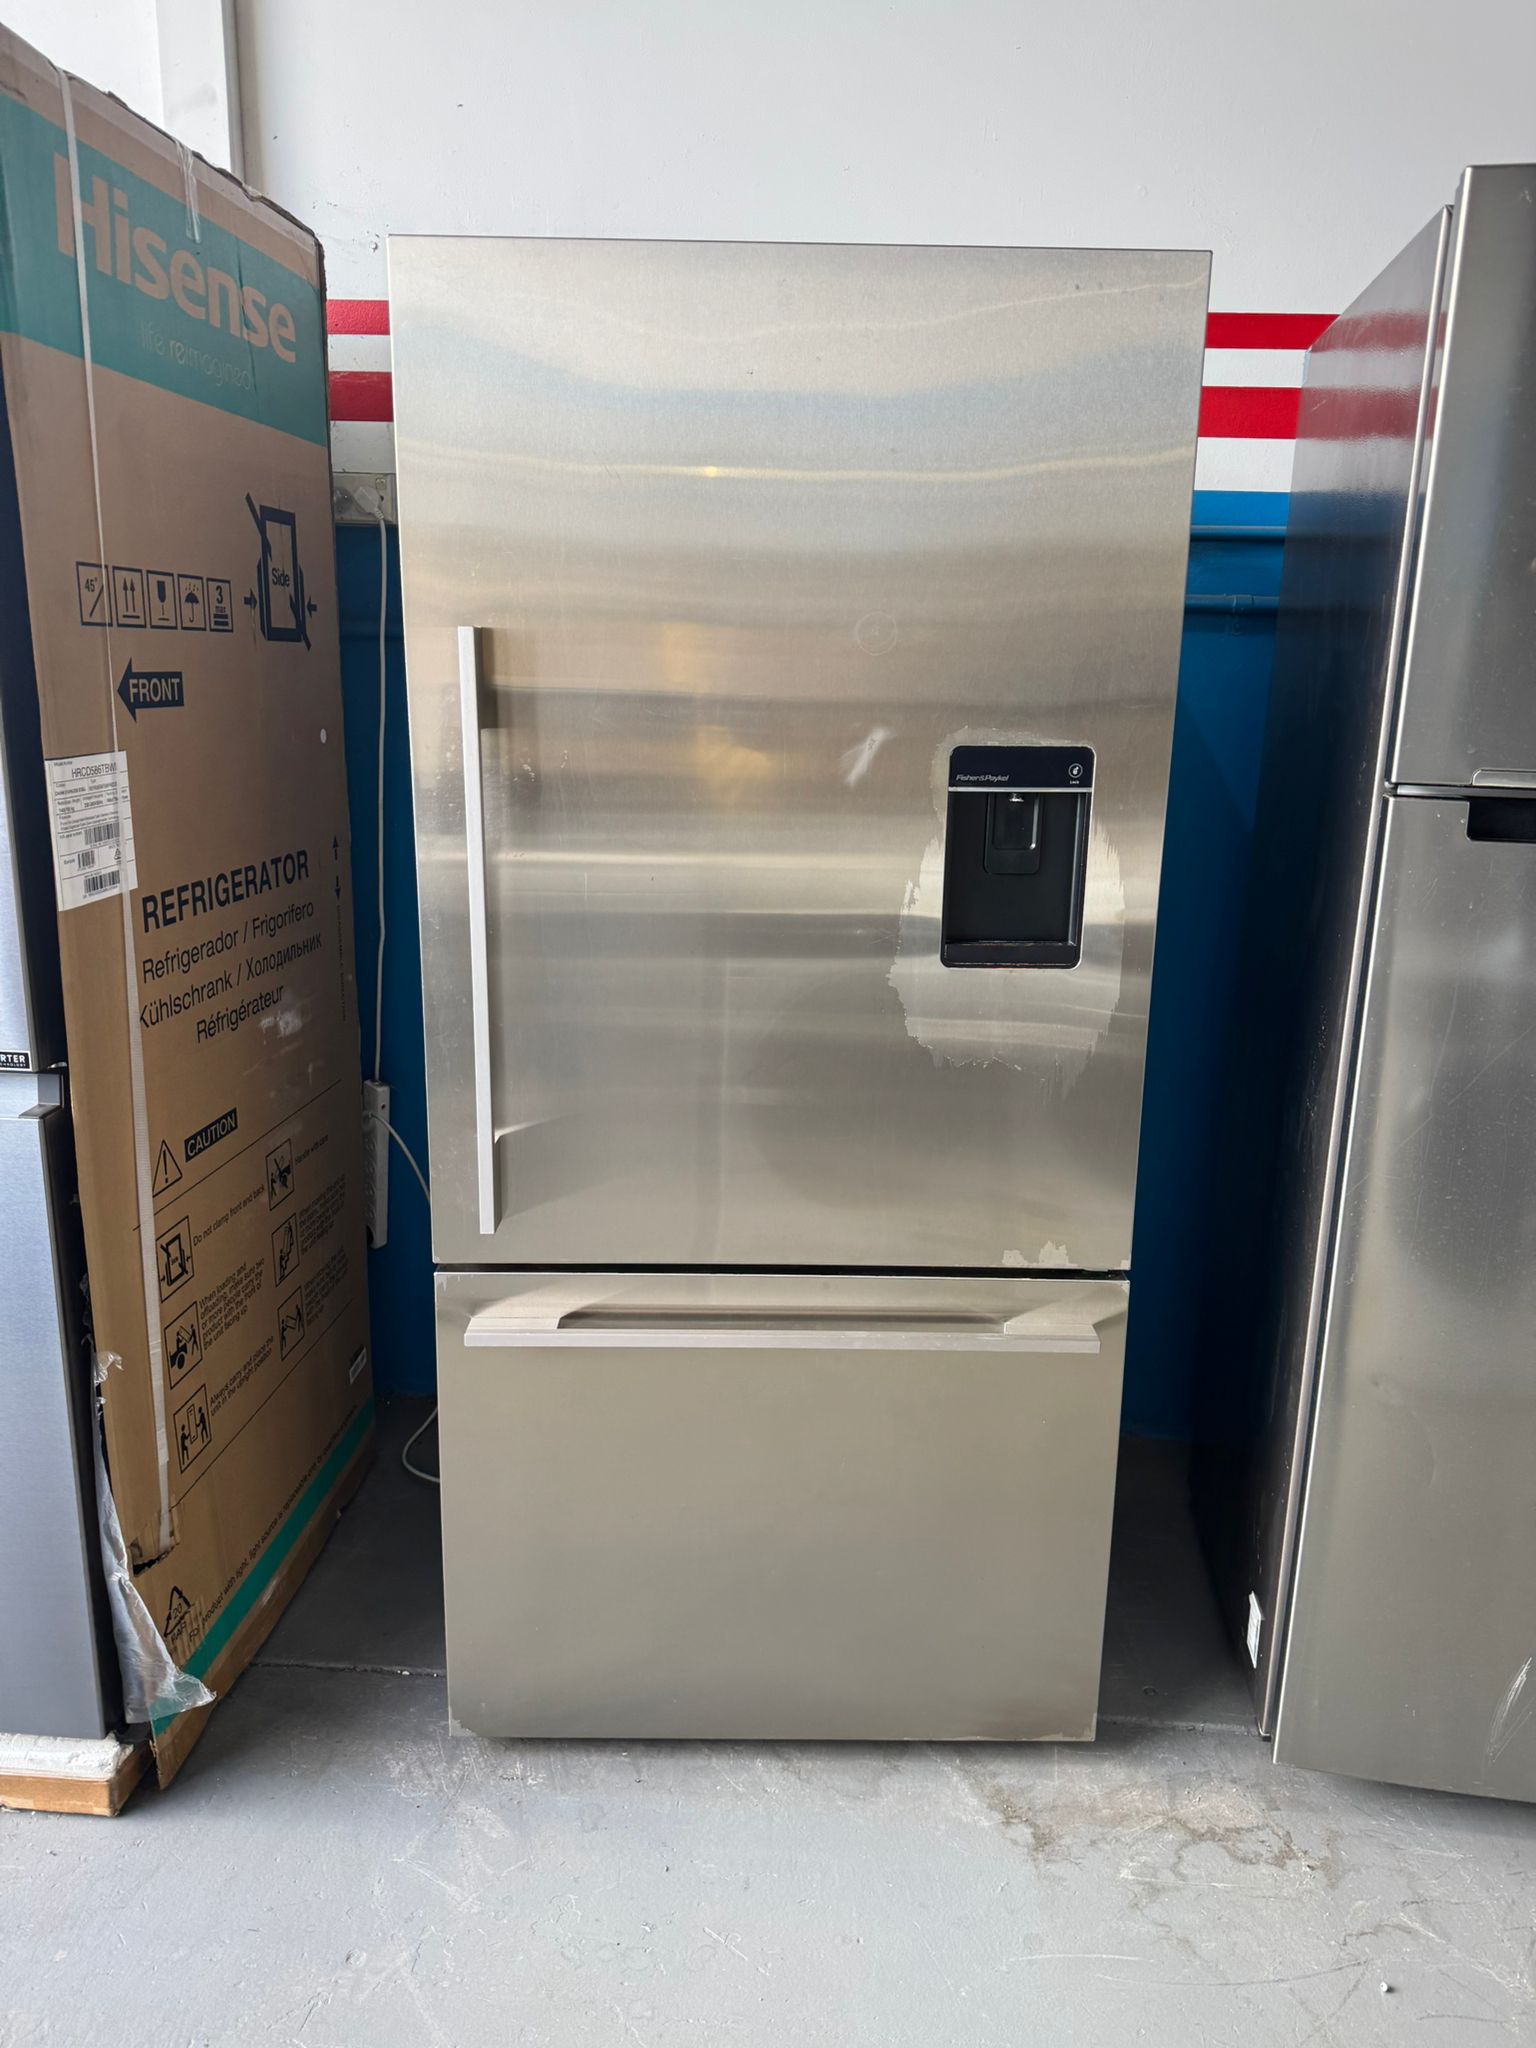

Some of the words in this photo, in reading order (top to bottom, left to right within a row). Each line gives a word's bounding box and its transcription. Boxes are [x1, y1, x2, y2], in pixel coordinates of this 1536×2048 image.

[53, 152, 296, 364] Hisense
[139, 320, 163, 356] life
[168, 339, 252, 390] reimagined
[215, 584, 224, 604] 3
[271, 567, 291, 588] Side
[128, 677, 181, 703] FRONT
[956, 774, 1010, 783] Fisher&Paykel
[142, 849, 310, 933] REFRIGERATOR
[142, 928, 239, 984] Refrigerador
[252, 900, 314, 940] Frigorifero
[246, 932, 323, 981] Холодильник
[196, 984, 285, 1043] Réfrigérateur
[186, 1112, 237, 1158] CAUTION
[192, 1235, 203, 1247] Do
[203, 1225, 213, 1239] not
[213, 1213, 229, 1231] clamp
[230, 1201, 242, 1218] front
[242, 1192, 253, 1208] and
[253, 1184, 265, 1201] back
[172, 1602, 183, 1620] 20
